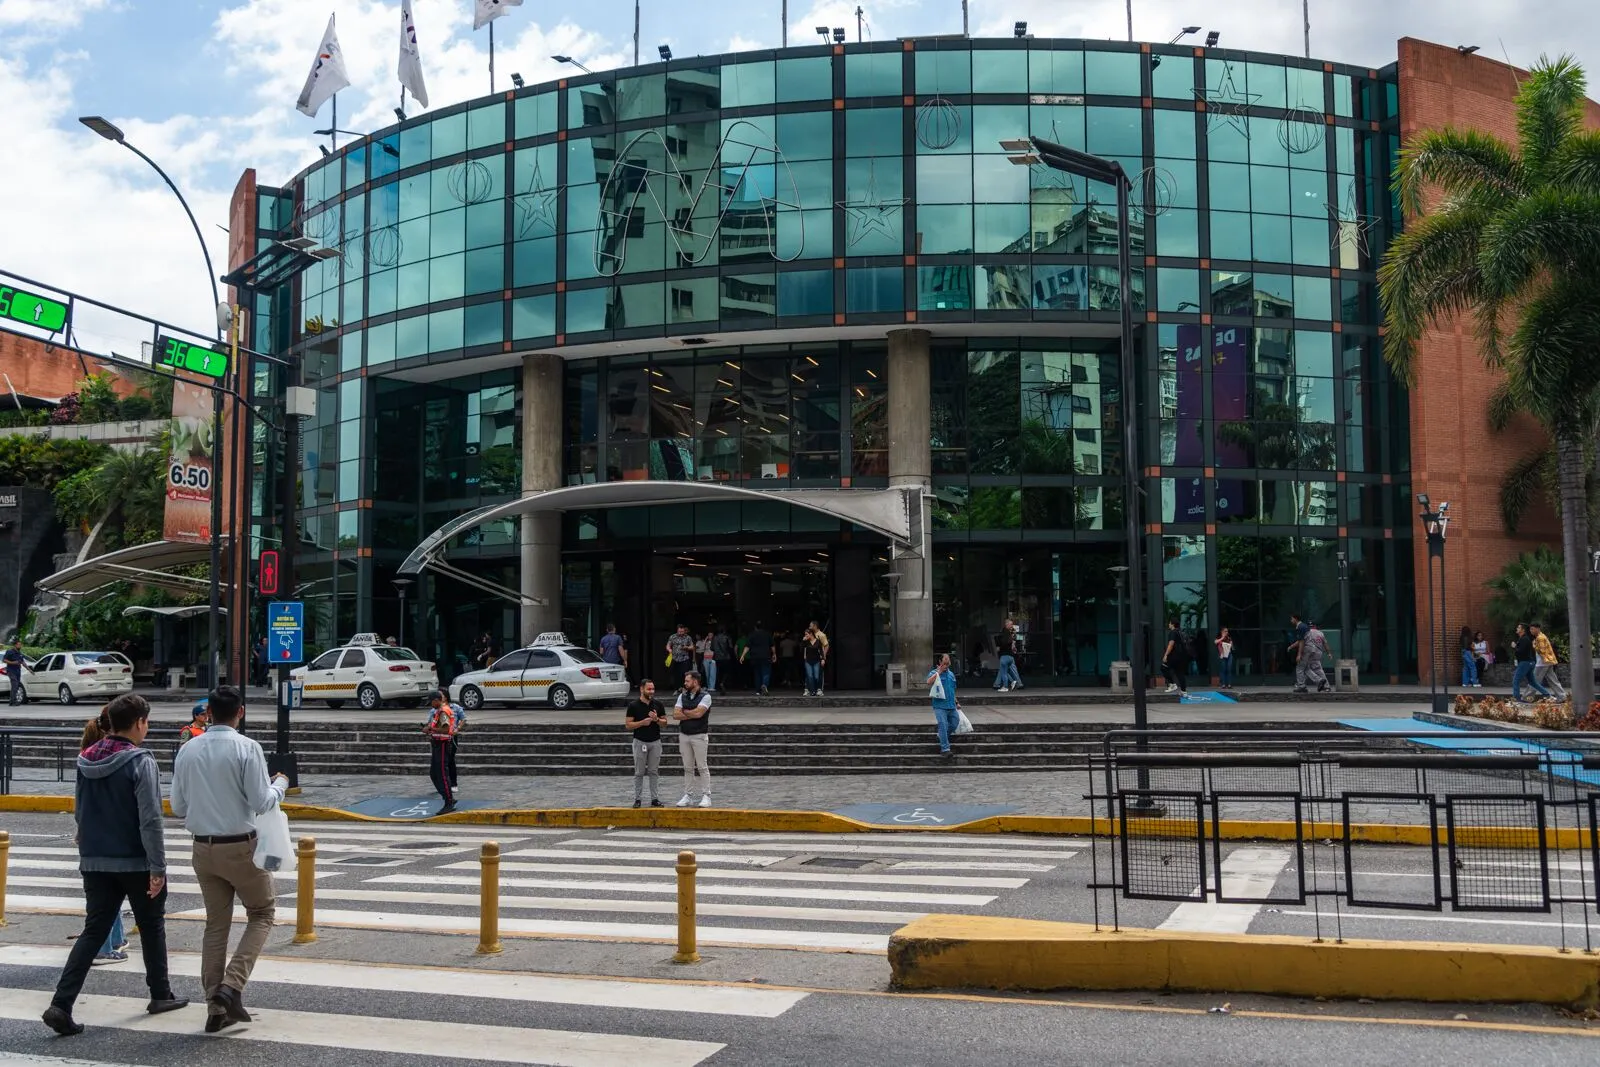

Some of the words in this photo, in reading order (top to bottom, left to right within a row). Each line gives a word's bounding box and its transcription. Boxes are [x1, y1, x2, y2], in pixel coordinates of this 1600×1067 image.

[163, 339, 188, 367] 36
[170, 464, 210, 489] 6.50
[538, 634, 561, 642] SAMBIL
